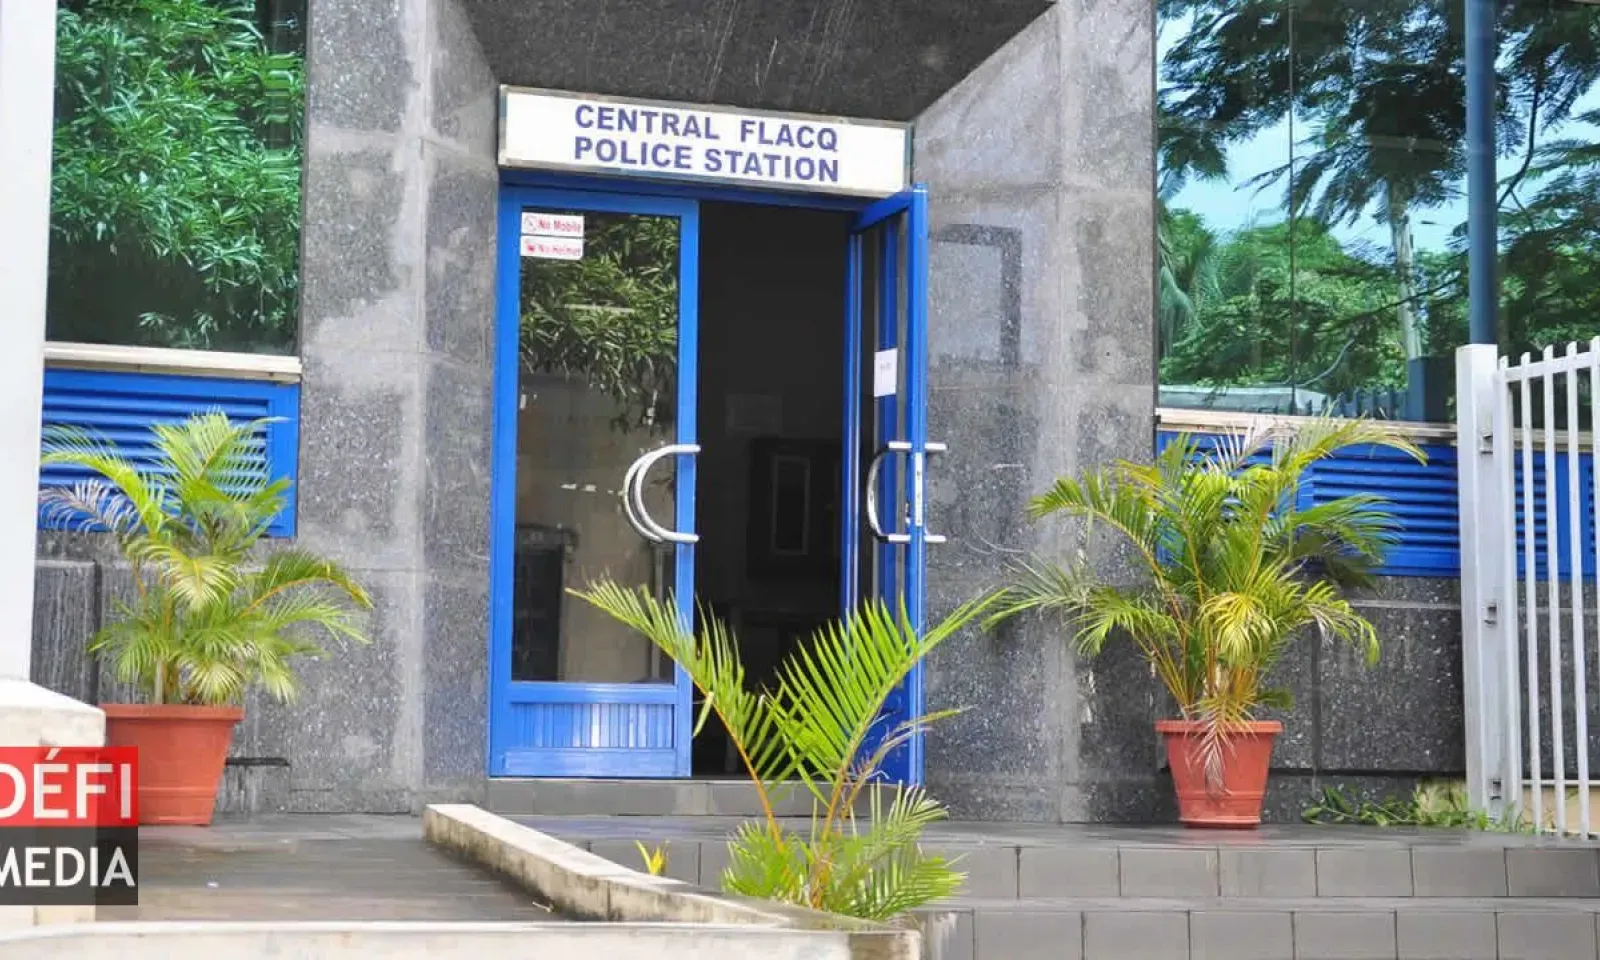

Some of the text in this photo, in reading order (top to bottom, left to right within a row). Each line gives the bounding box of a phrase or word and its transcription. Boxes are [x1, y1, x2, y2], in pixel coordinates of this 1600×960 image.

[575, 104, 838, 153] CENTRAL FLACQ
[574, 136, 839, 183] POLICE STATION
